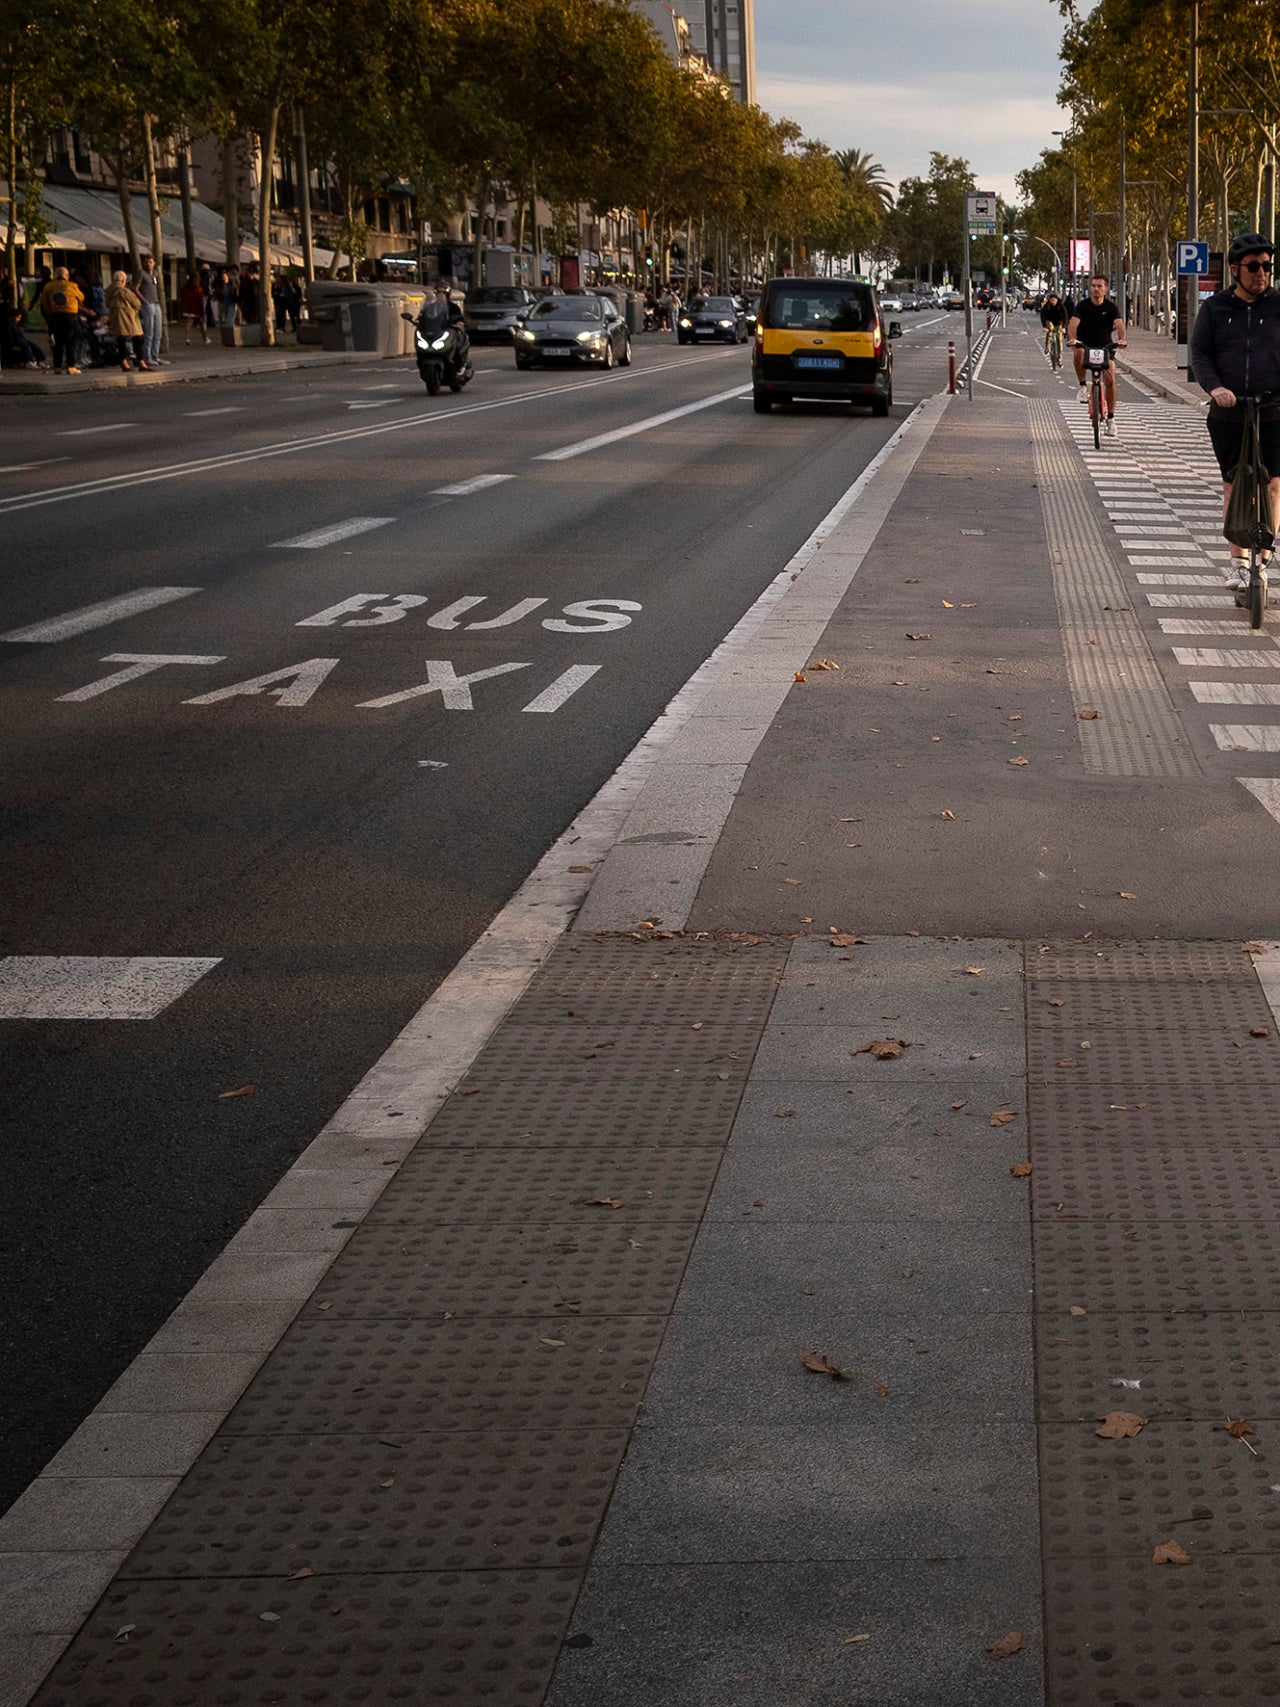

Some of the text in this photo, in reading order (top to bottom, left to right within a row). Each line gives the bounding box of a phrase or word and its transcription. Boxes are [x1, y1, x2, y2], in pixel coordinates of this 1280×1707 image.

[1180, 245, 1198, 268] P
[295, 593, 643, 633] BUS
[53, 653, 603, 713] TAXI
